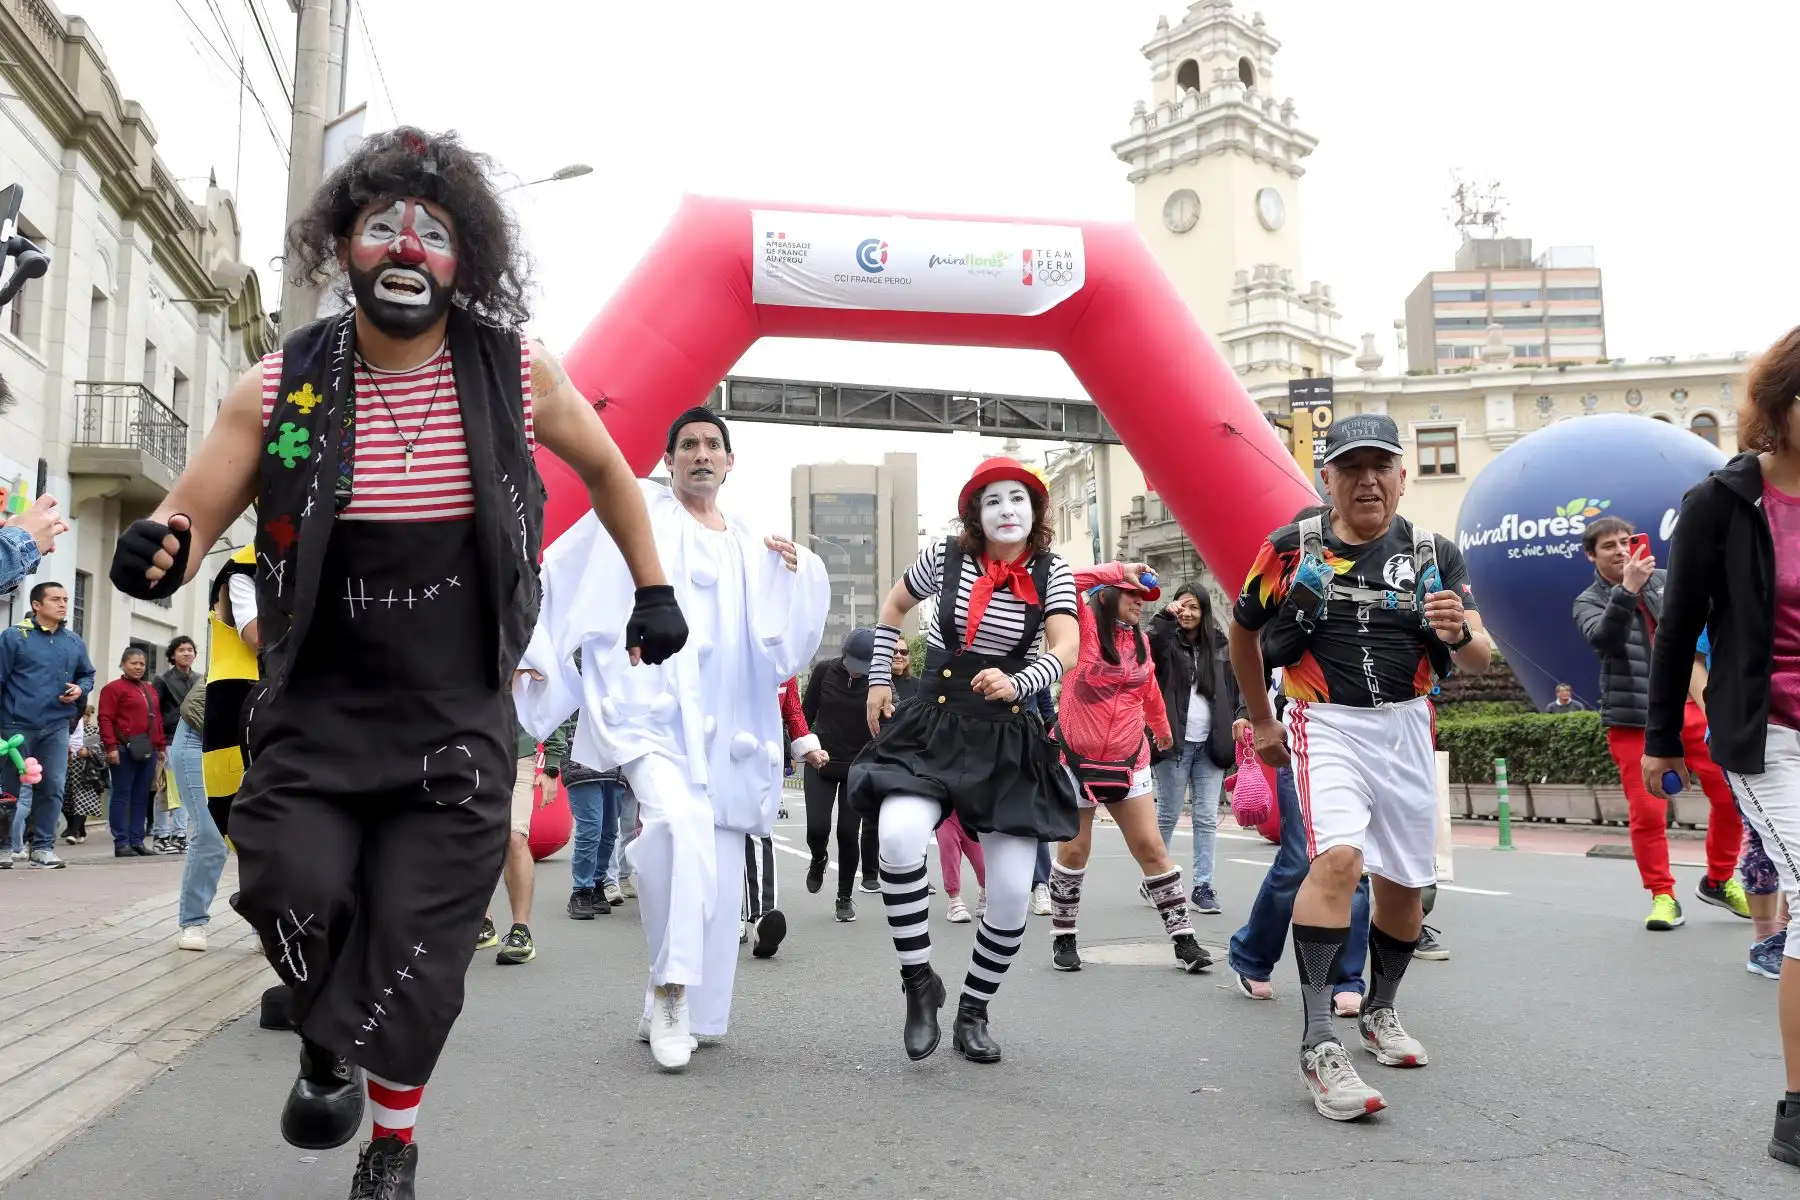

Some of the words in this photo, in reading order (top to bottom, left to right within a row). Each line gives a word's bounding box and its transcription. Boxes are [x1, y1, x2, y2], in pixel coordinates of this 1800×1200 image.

[766, 241, 811, 249] AMBASSADE
[777, 249, 808, 257] FRANCE
[1036, 249, 1072, 258] TEAM
[928, 252, 1004, 269] miraflores
[1037, 259, 1073, 270] PERÚ
[834, 274, 849, 283] CCI
[850, 275, 883, 284] FRANCE
[1341, 420, 1381, 433] RUNNER
[1459, 513, 1586, 551] miraflores
[1507, 546, 1521, 559] se
[1522, 544, 1544, 557] vive
[1545, 540, 1583, 559] mejor
[1360, 646, 1383, 708] TEAM
